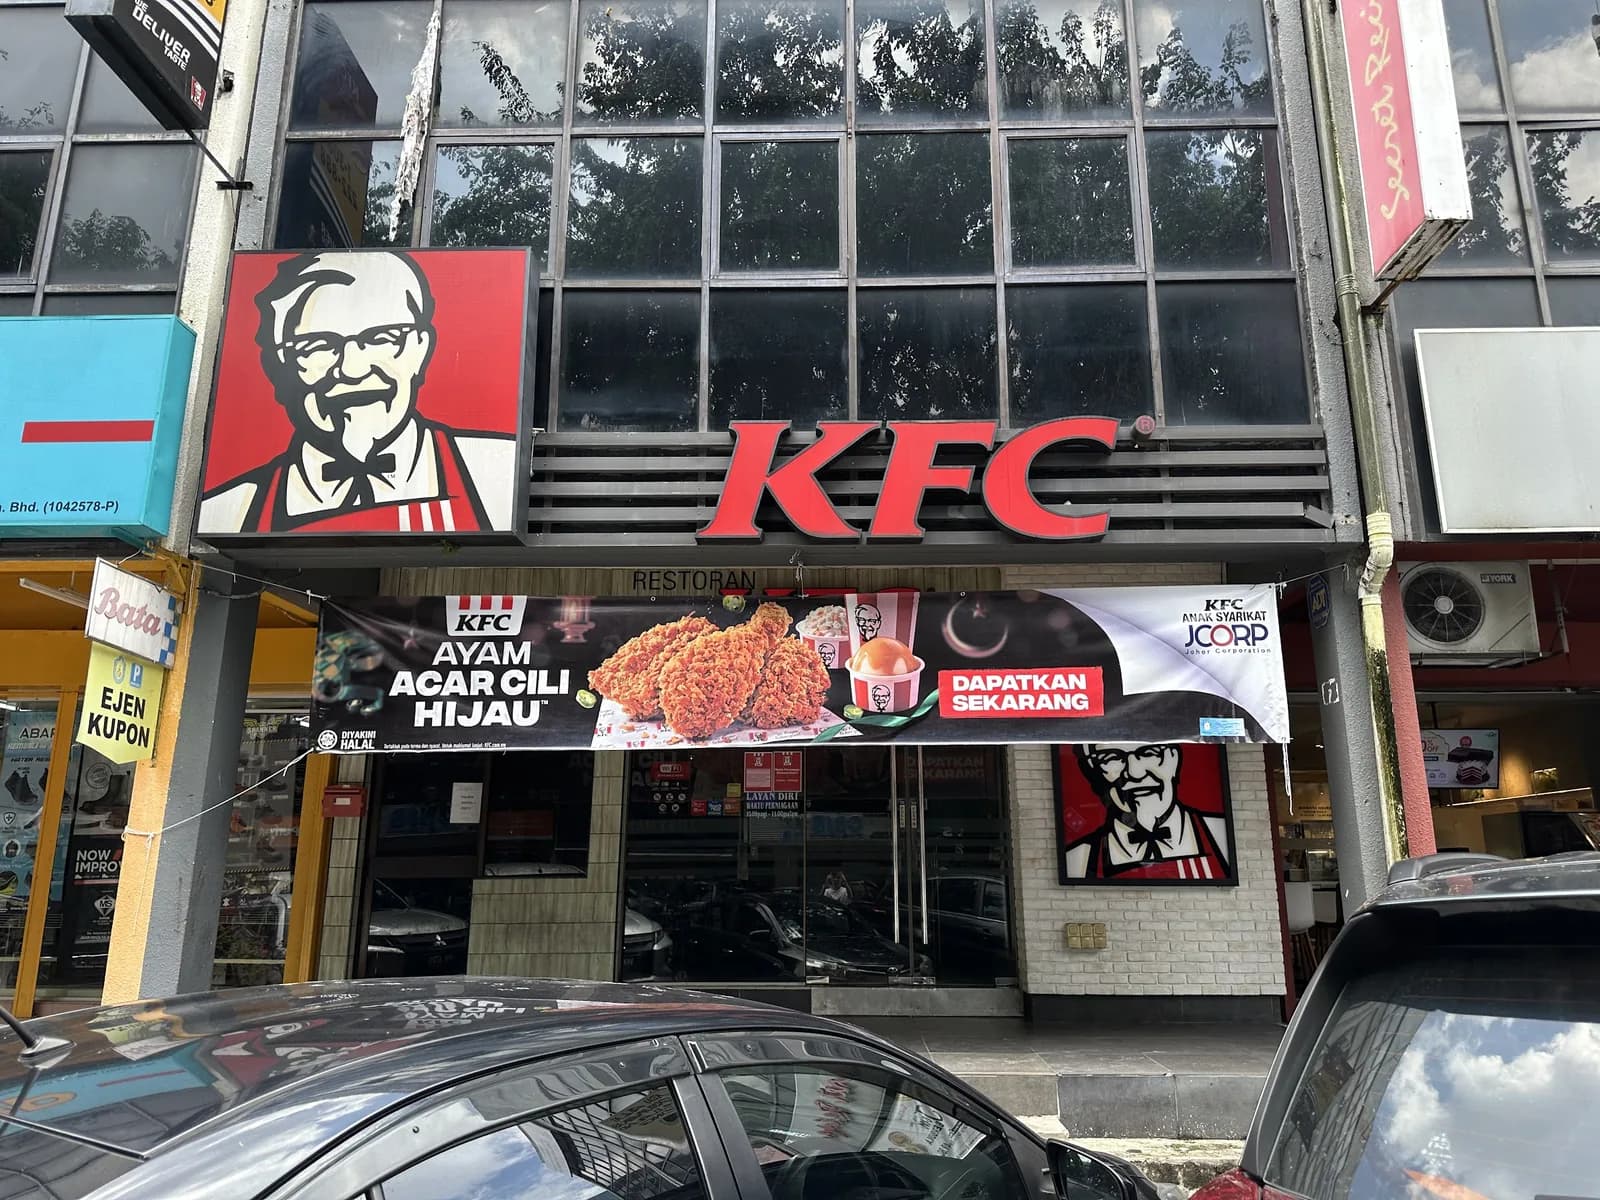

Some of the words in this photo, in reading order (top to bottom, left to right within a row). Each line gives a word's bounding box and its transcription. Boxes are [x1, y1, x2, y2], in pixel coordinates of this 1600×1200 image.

[132, 5, 191, 63] DELIVER
[163, 46, 187, 71] TASTE
[1371, 85, 1410, 220] Secret
[695, 415, 1122, 543] KFC
[9, 502, 39, 513] Bhd.
[43, 500, 119, 514] (1042578-P)
[633, 571, 756, 591] RESTORAN
[1489, 574, 1514, 583] YORK
[94, 587, 161, 636] Bata
[1204, 598, 1244, 611] KFC
[455, 614, 512, 632] KFC
[1183, 612, 1213, 623] ANAK
[1216, 611, 1267, 622] SYARIKAT
[1185, 624, 1269, 647] JCORP
[432, 641, 531, 666] AYAM
[1215, 647, 1272, 655] Corporation
[389, 670, 495, 697] ACAR
[500, 669, 570, 695] CILI
[952, 673, 1087, 691] DAPATKAN
[101, 686, 146, 719] EJEN
[952, 693, 1089, 711] SEKARANG
[414, 700, 541, 728] HIJAU
[87, 713, 151, 748] KUPON
[341, 730, 377, 739] DIYAKINI
[340, 739, 376, 750] HALAL
[746, 792, 776, 801] LAYAN
[778, 792, 798, 801] DIRI
[77, 850, 111, 861] NOW
